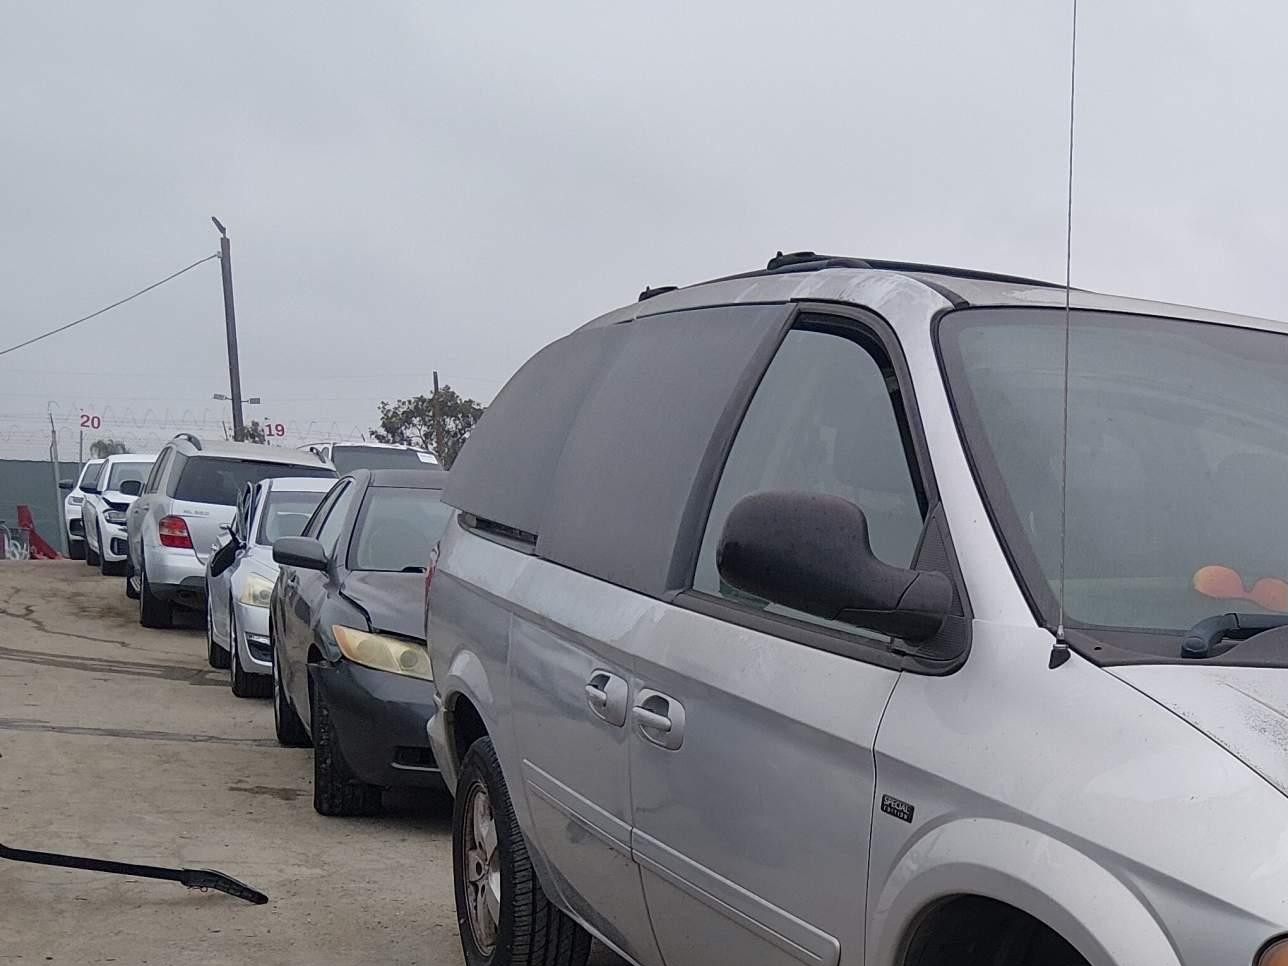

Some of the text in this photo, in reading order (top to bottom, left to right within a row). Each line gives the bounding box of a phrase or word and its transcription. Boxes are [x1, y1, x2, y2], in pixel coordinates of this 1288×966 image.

[81, 414, 101, 430] 20
[265, 423, 285, 437] 19
[884, 796, 909, 815] SPECIAL
